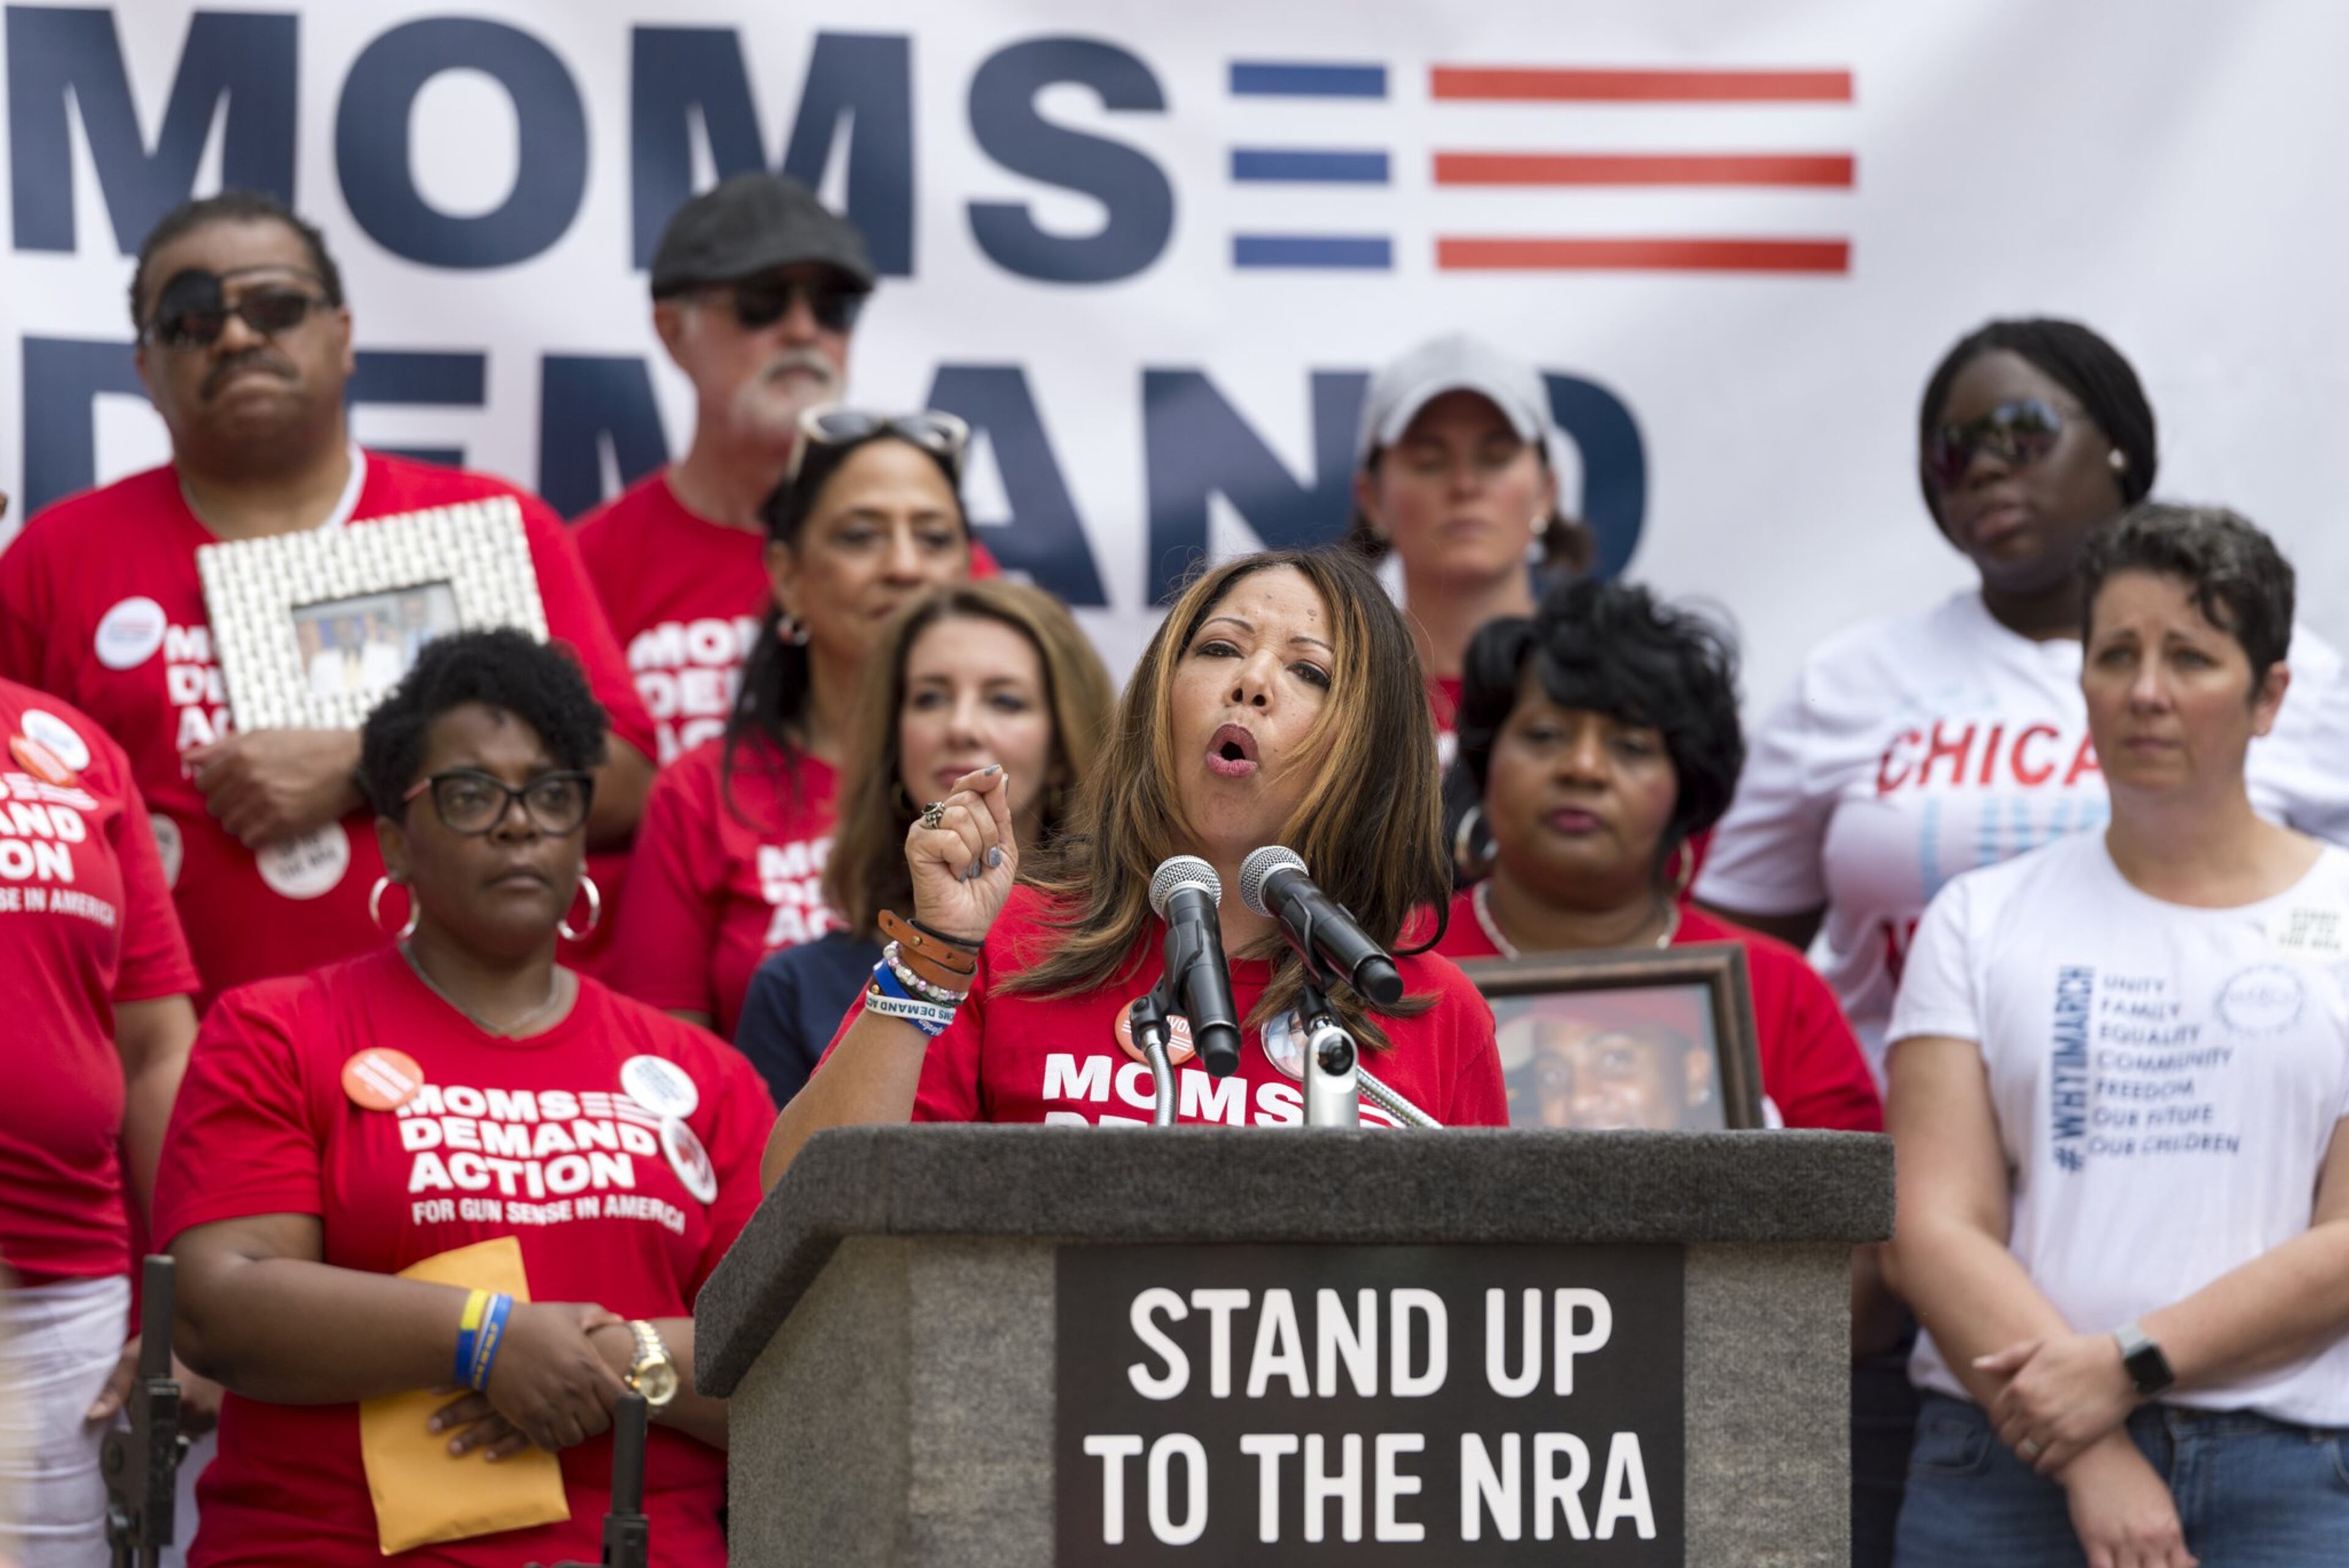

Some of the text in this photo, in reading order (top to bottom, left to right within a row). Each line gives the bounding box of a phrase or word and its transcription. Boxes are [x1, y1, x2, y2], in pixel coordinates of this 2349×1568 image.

[5, 5, 1174, 286] MOMS
[2104, 976, 2165, 992] UNITY
[880, 1001, 935, 1017] DEMAND
[2101, 997, 2181, 1020] FAMILY
[2099, 1023, 2202, 1046] EQUALITY
[2097, 1047, 2234, 1072] COMMUNITY
[1042, 1053, 1304, 1127] MOMS
[2095, 1077, 2194, 1100] FREEDOM
[396, 1084, 581, 1123] MOMS
[2092, 1106, 2139, 1126] OUR
[398, 1116, 658, 1158] DEMAND
[2087, 1132, 2240, 1156] OUR CHILDREN
[408, 1151, 636, 1198] ACTION
[411, 1198, 455, 1226] FOR
[459, 1197, 502, 1222] GUN
[506, 1200, 574, 1226] SENSE
[576, 1197, 600, 1219] IN
[1127, 1287, 1612, 1400] STAND UP
[1083, 1432, 1657, 1545] TO THE NRA
